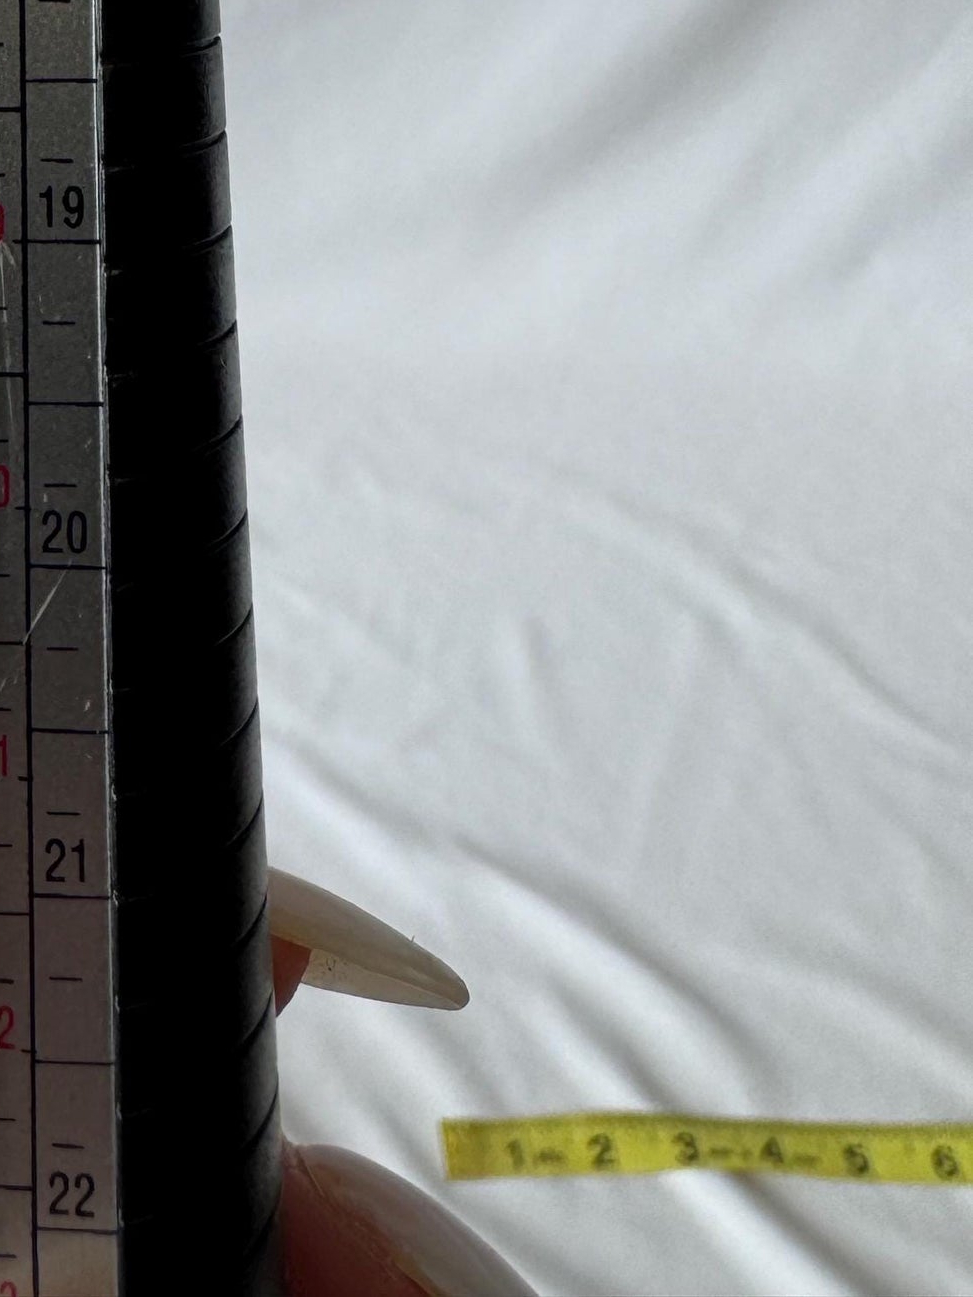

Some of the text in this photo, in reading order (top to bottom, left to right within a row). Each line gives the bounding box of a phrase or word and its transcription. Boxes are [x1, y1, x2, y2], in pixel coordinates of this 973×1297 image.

[39, 185, 85, 230] 19
[41, 509, 88, 554] 20
[45, 838, 86, 884] 21
[587, 1132, 615, 1167] 2
[671, 1131, 701, 1166] 3
[760, 1136, 784, 1165] 4
[842, 1142, 872, 1177] 5
[49, 1171, 96, 1218] 22
